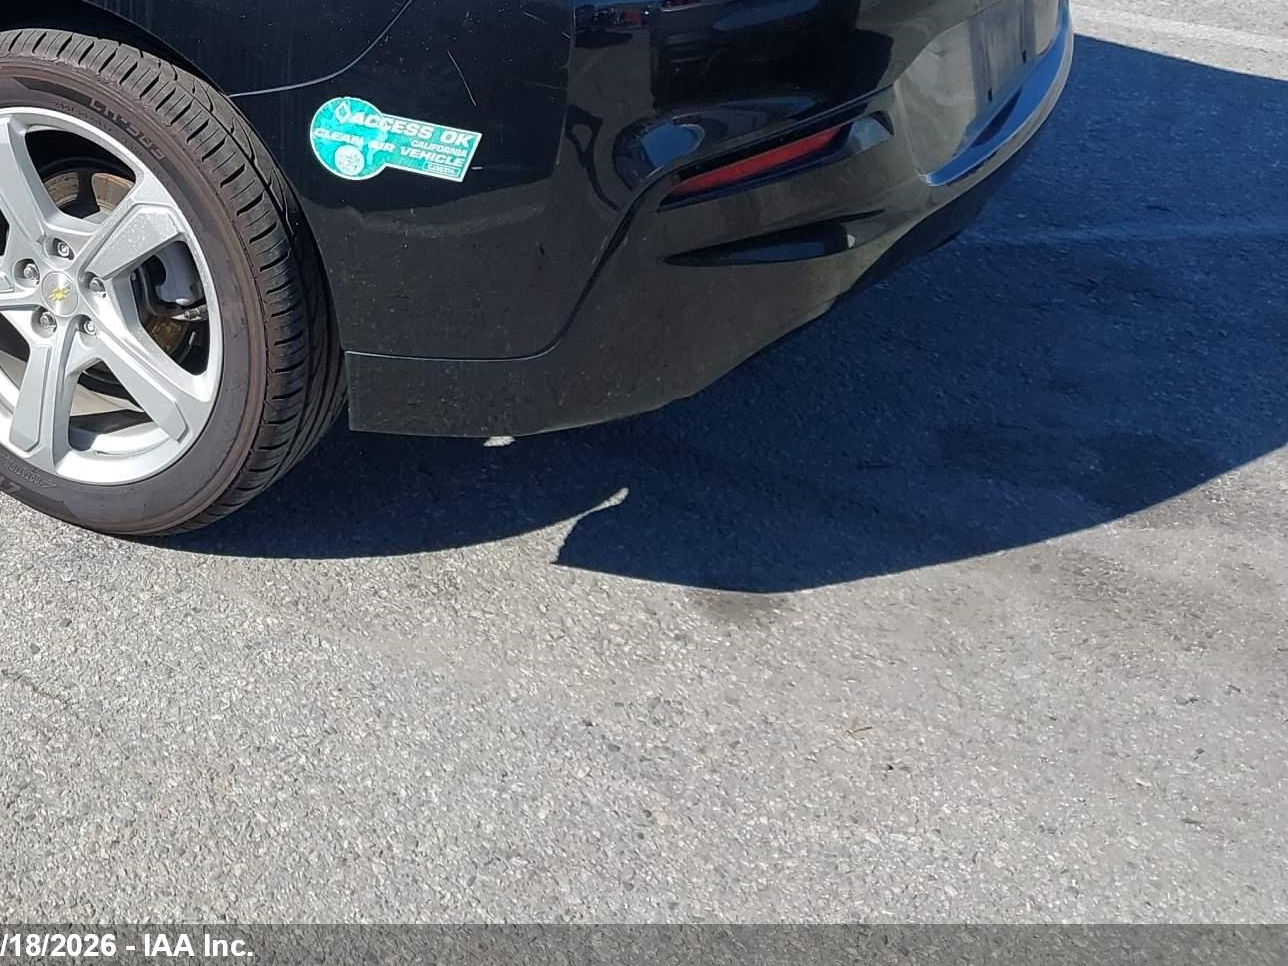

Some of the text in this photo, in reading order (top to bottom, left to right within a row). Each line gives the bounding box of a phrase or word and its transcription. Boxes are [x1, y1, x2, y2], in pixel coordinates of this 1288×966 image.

[352, 112, 474, 147] ACCESS OK
[313, 129, 364, 146] CLEAN
[400, 146, 466, 166] VEHICLE
[411, 140, 467, 157] CALIFORNIA
